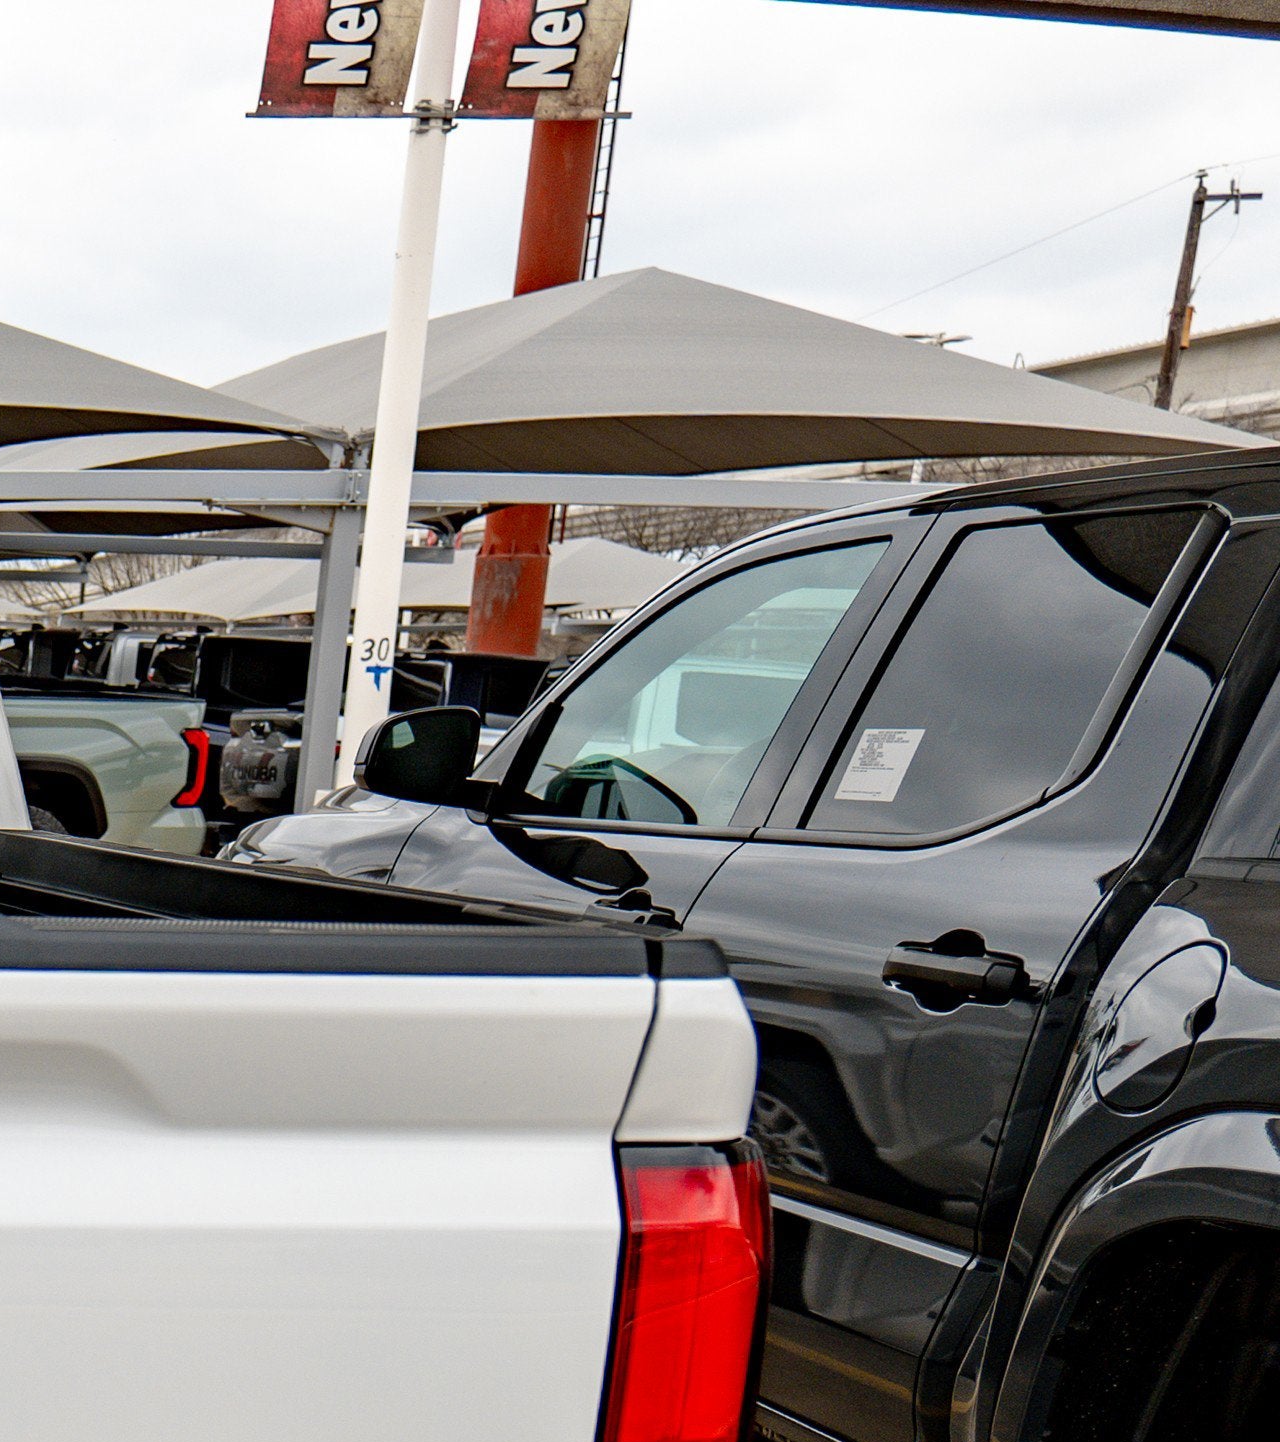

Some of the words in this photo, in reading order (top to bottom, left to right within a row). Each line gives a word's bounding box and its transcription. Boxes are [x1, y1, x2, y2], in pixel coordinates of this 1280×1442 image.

[303, 0, 382, 85] Ne
[506, 0, 587, 88] Ne
[360, 637, 390, 662] 30
